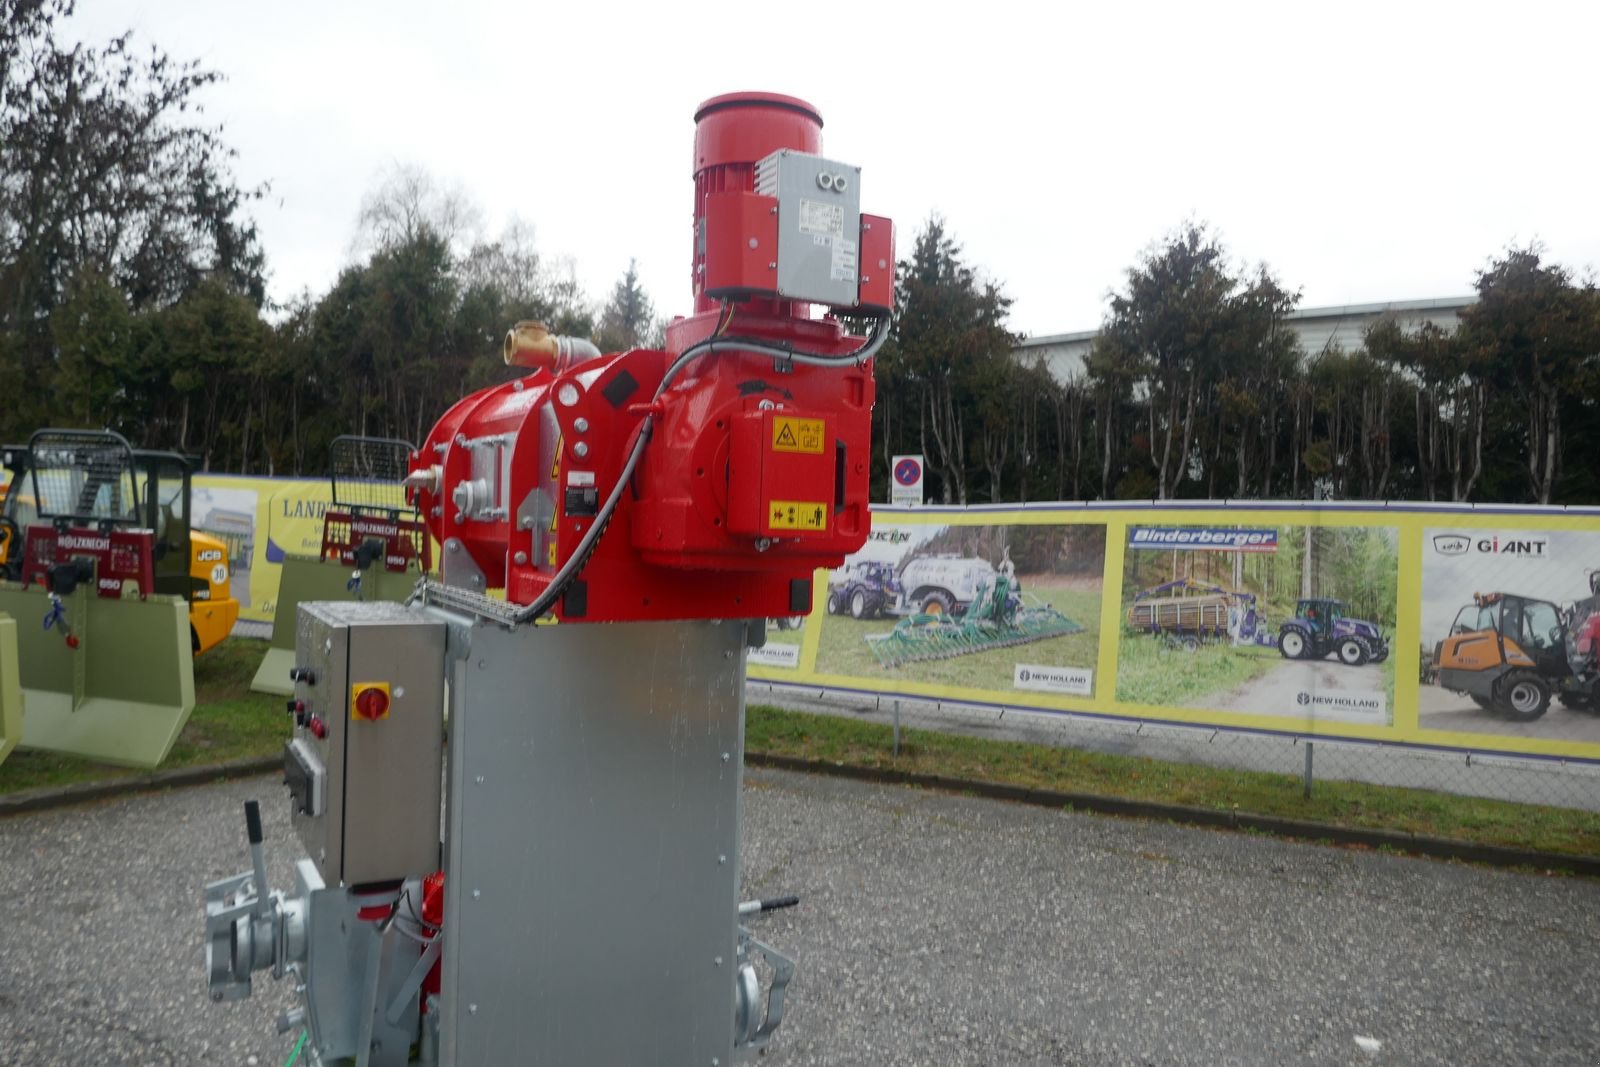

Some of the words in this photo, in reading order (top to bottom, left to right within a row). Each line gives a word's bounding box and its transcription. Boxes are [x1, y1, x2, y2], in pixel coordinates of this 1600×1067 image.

[1134, 528, 1273, 546] Binderberger
[197, 550, 221, 562] JCB
[1032, 672, 1049, 681] NEW
[1050, 673, 1086, 683] HOLLAND
[1312, 696, 1333, 705] NEW
[1335, 698, 1379, 708] HOLLAND
